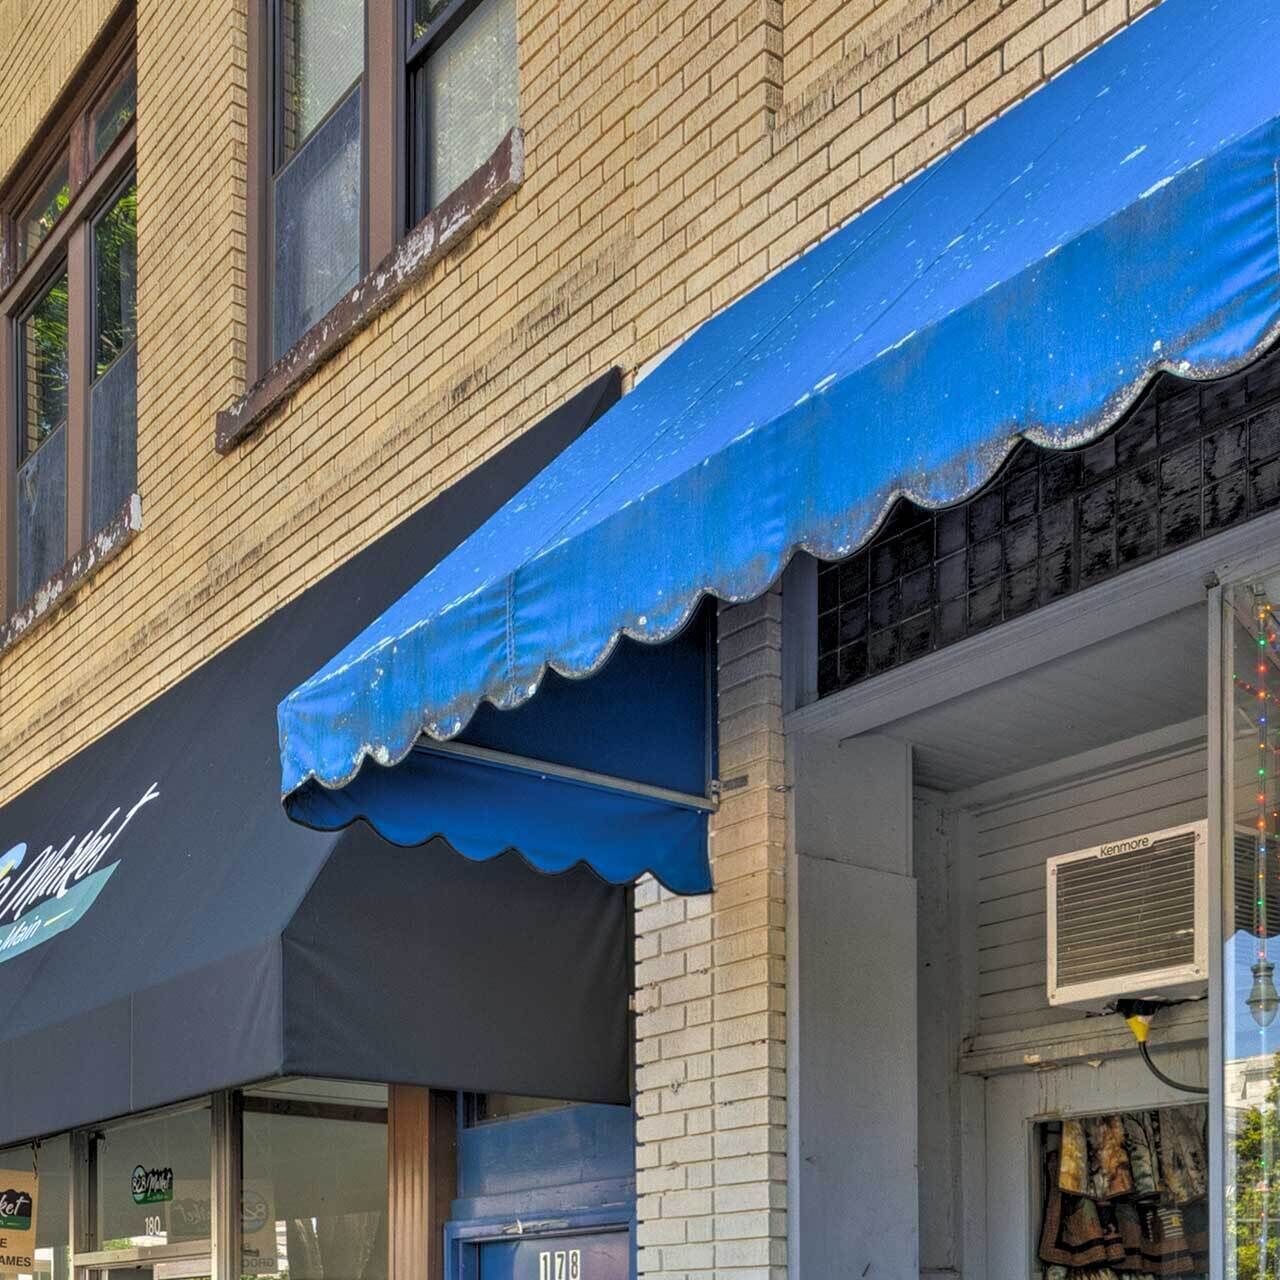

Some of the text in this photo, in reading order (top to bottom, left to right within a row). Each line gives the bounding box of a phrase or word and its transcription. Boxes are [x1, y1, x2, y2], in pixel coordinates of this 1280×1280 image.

[1100, 837, 1149, 857] Kenmore
[145, 1216, 161, 1236] 180
[542, 1250, 579, 1280] 178
